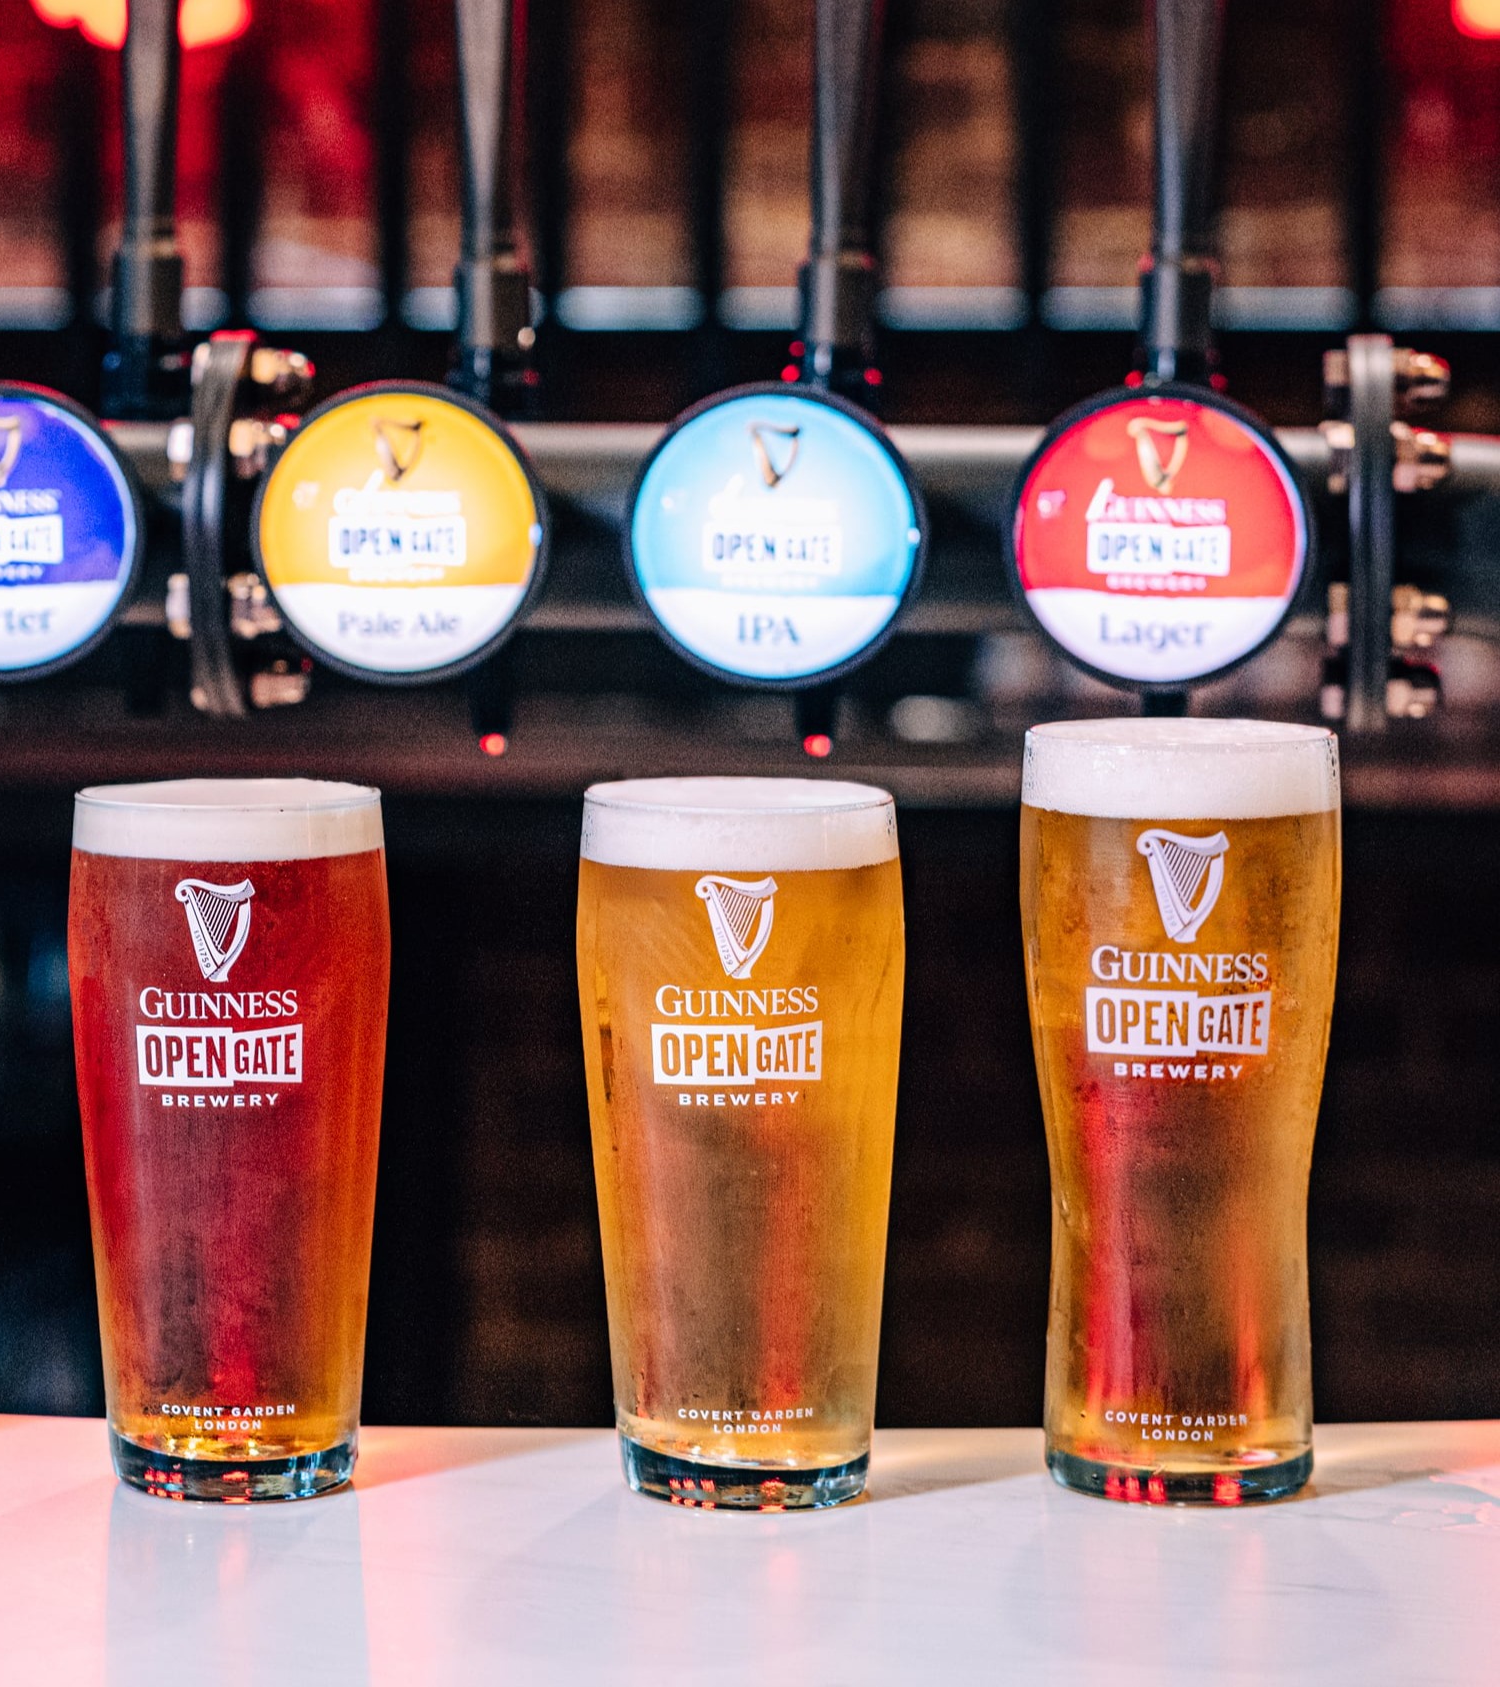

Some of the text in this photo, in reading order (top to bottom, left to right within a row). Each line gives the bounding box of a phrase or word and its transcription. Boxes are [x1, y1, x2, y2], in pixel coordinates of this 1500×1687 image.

[340, 528, 402, 555] OPEN
[712, 532, 776, 562] OPEN
[1097, 533, 1163, 562] OPEN
[338, 611, 462, 635] Pale Ale
[737, 613, 801, 644] IPA
[1098, 613, 1212, 653] Lager
[1091, 945, 1269, 983] GUINNESS
[139, 987, 298, 1019] GUINNESS
[655, 984, 819, 1018] GUINNESS
[1095, 997, 1265, 1047] OPEN GATE
[144, 1032, 297, 1078] OPEN GATE
[660, 1029, 817, 1077] OPEN GATE
[1113, 1062, 1244, 1079] BREWERY
[162, 1093, 279, 1107] BREWERY
[679, 1091, 799, 1106] BREWERY
[161, 1403, 296, 1417] COVENT GARDEN
[677, 1407, 814, 1421] COVENT GARDEN
[1104, 1410, 1248, 1427] COVENT GARDEN
[194, 1419, 262, 1431] LONDON
[713, 1423, 782, 1434] LONDON
[1141, 1428, 1214, 1442] LONDON
